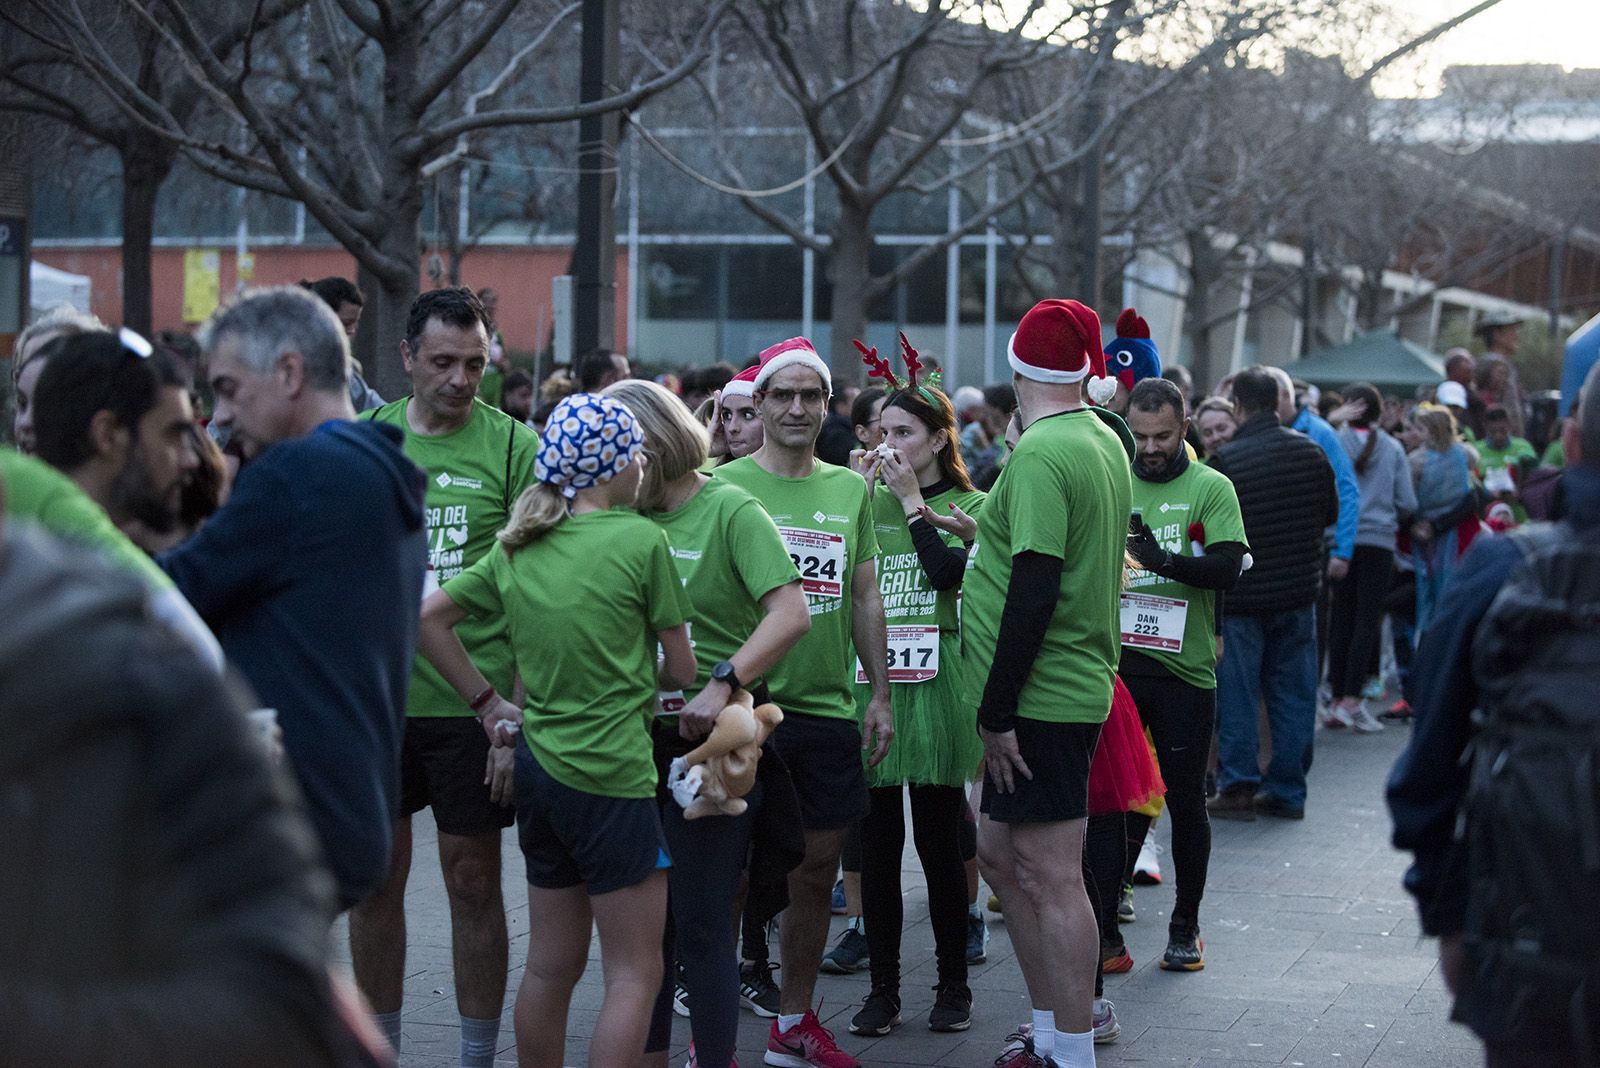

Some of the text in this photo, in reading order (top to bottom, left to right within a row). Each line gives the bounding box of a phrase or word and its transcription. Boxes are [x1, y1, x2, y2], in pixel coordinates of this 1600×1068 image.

[444, 505, 468, 525] DEL
[1164, 523, 1181, 539] DEL
[883, 552, 919, 571] CURSA
[880, 569, 922, 595] GALL
[881, 593, 905, 609] ANT
[910, 606, 919, 616] DE
[1137, 613, 1158, 624] DANI
[1134, 623, 1159, 636] 222
